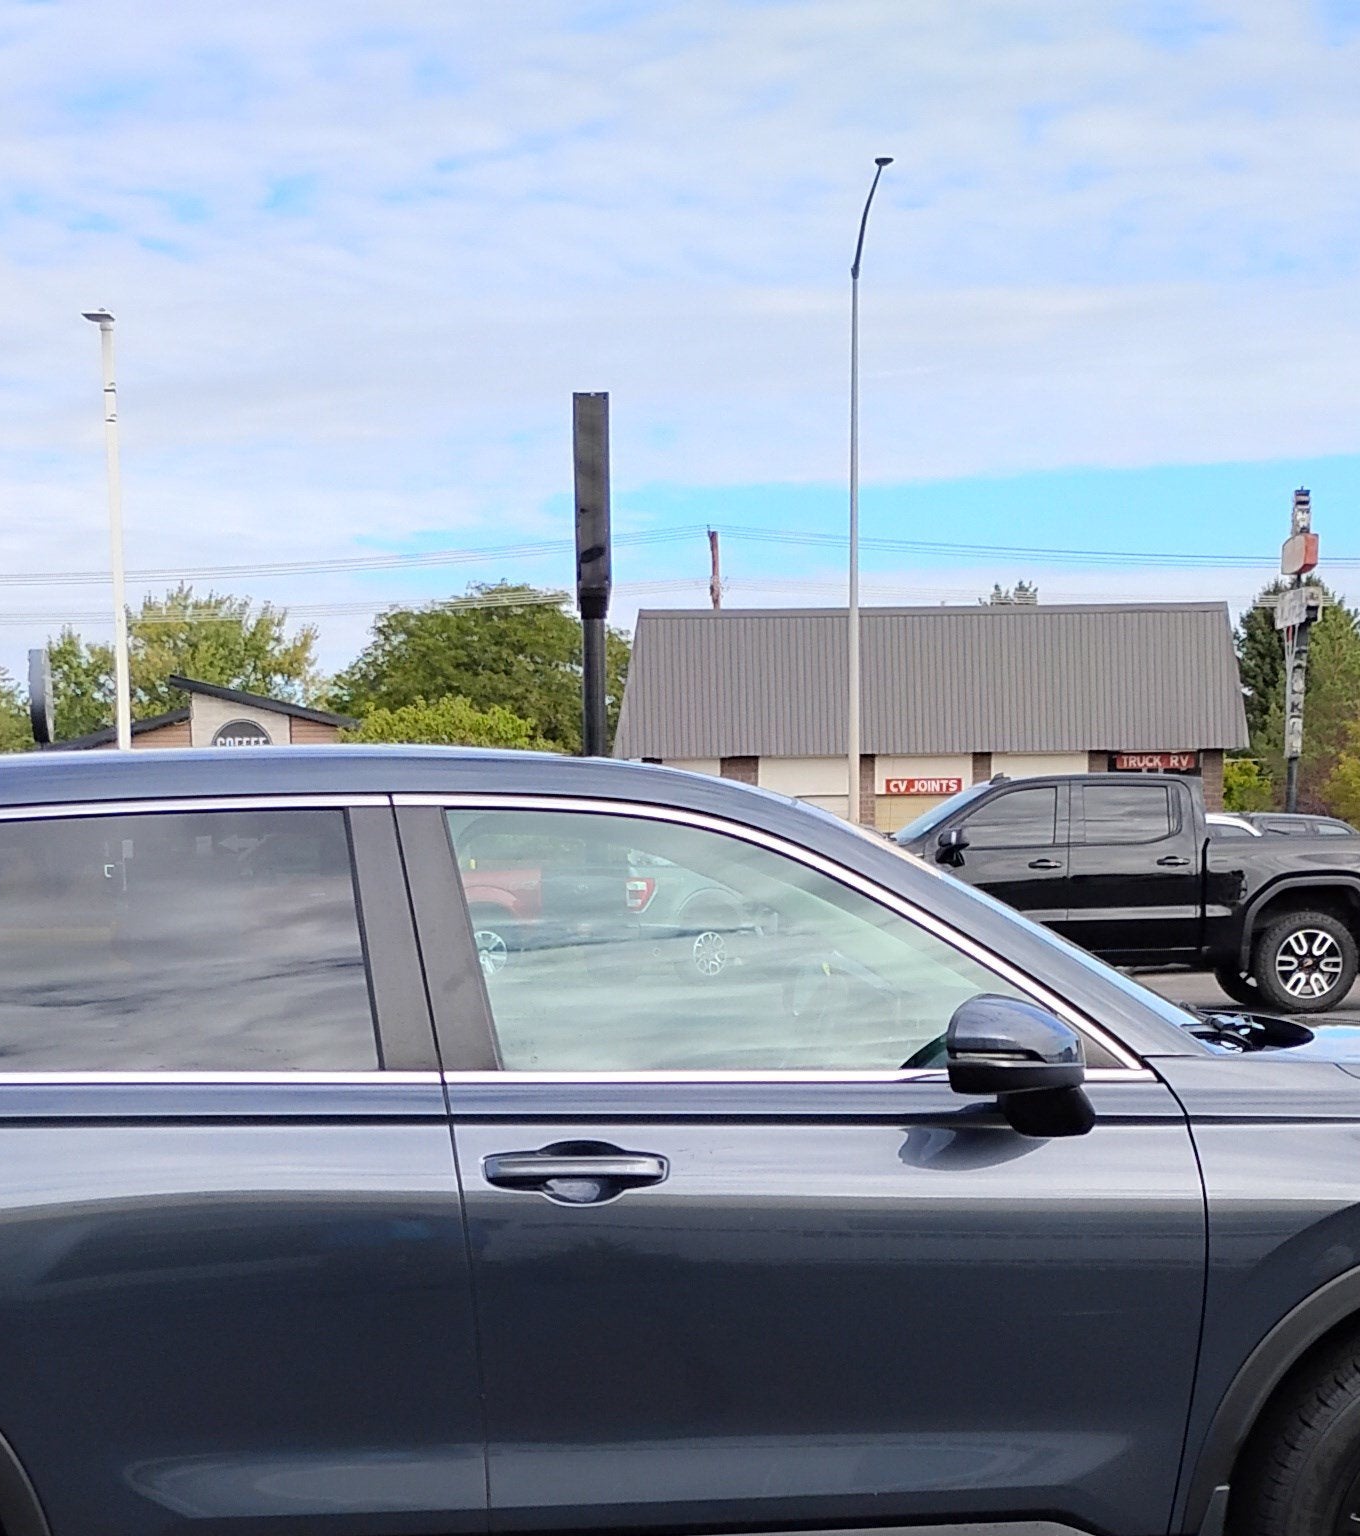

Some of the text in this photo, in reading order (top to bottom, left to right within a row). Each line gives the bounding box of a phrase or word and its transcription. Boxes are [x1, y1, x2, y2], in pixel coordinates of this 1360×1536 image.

[1121, 754, 1190, 767] TRUCK RV
[889, 779, 958, 793] CV JOINTS
